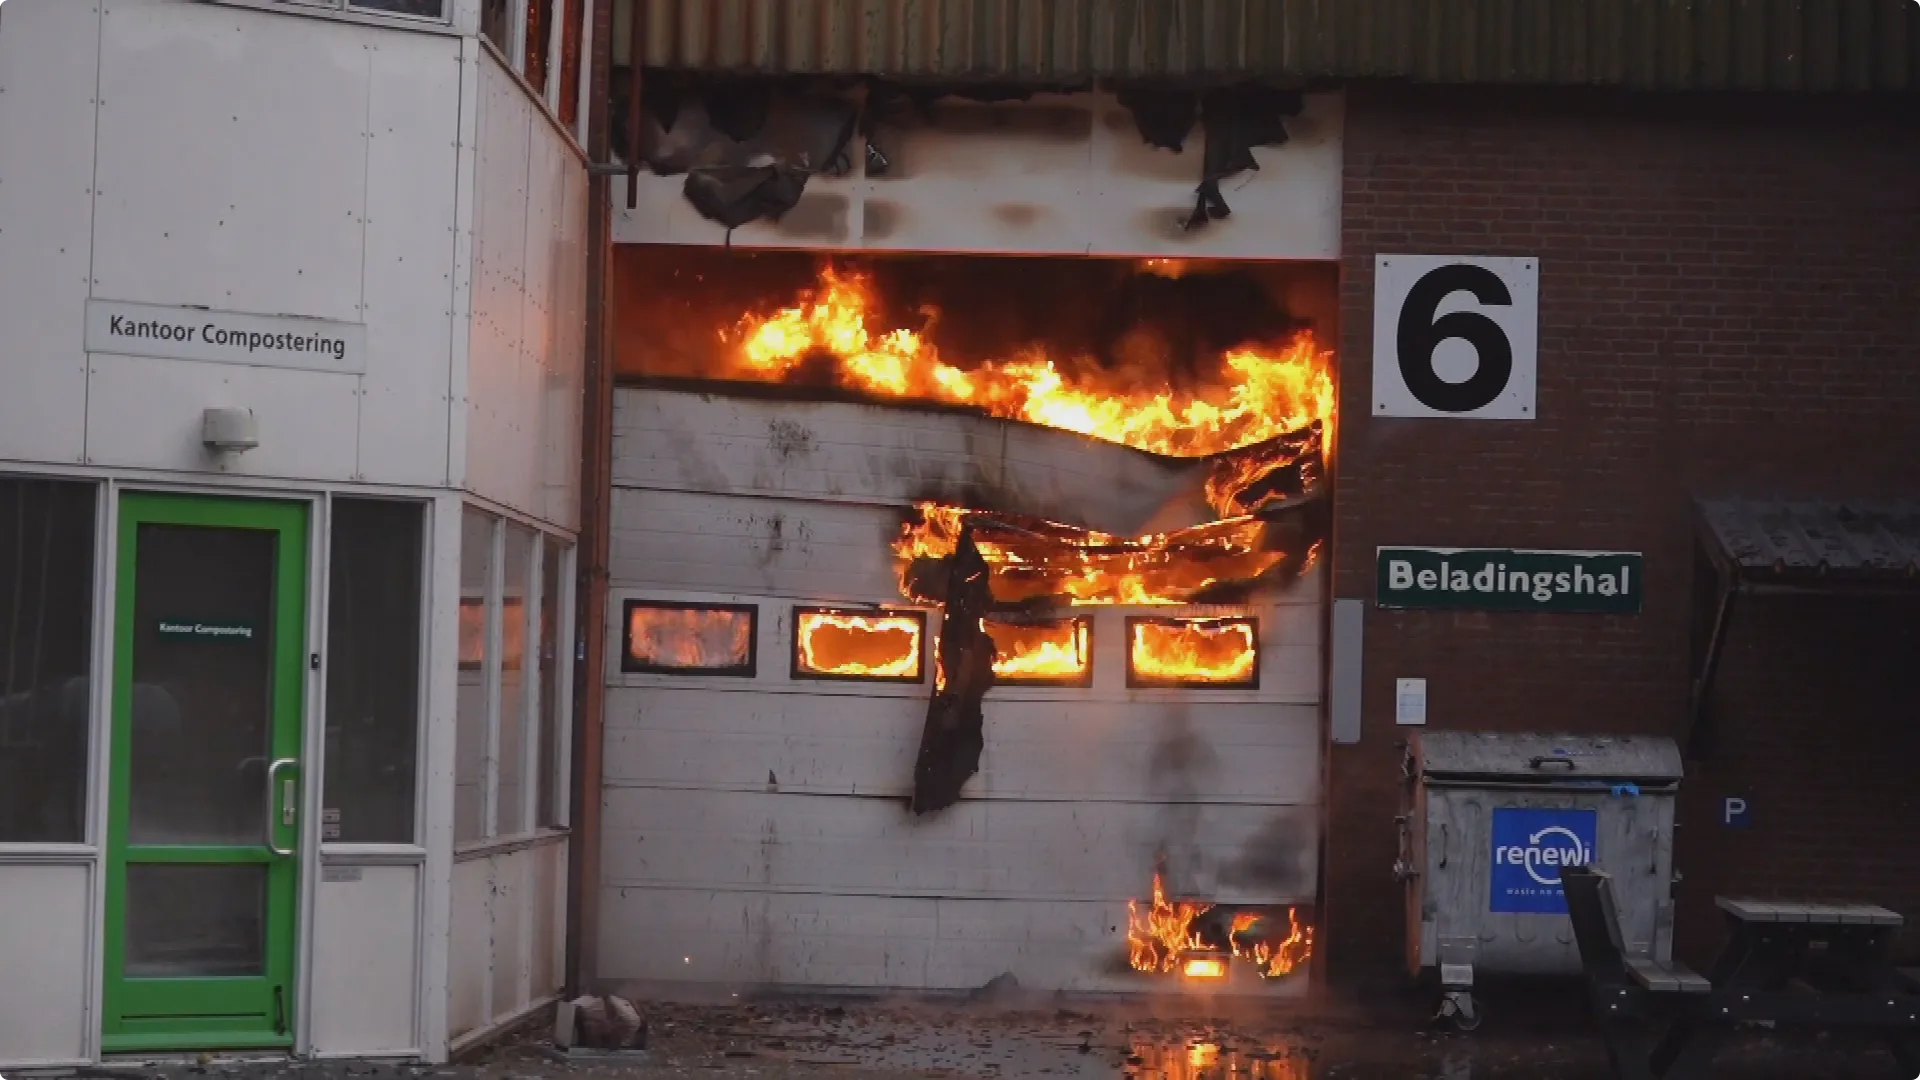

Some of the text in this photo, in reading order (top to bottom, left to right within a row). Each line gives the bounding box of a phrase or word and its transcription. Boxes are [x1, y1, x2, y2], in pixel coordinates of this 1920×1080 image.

[109, 314, 345, 360] Kantoor Compostering
[1396, 263, 1513, 413] 6
[1388, 559, 1629, 602] Beladingshal
[159, 622, 193, 633] Kantoor
[1725, 797, 1746, 823] P
[1496, 842, 1591, 867] renewi
